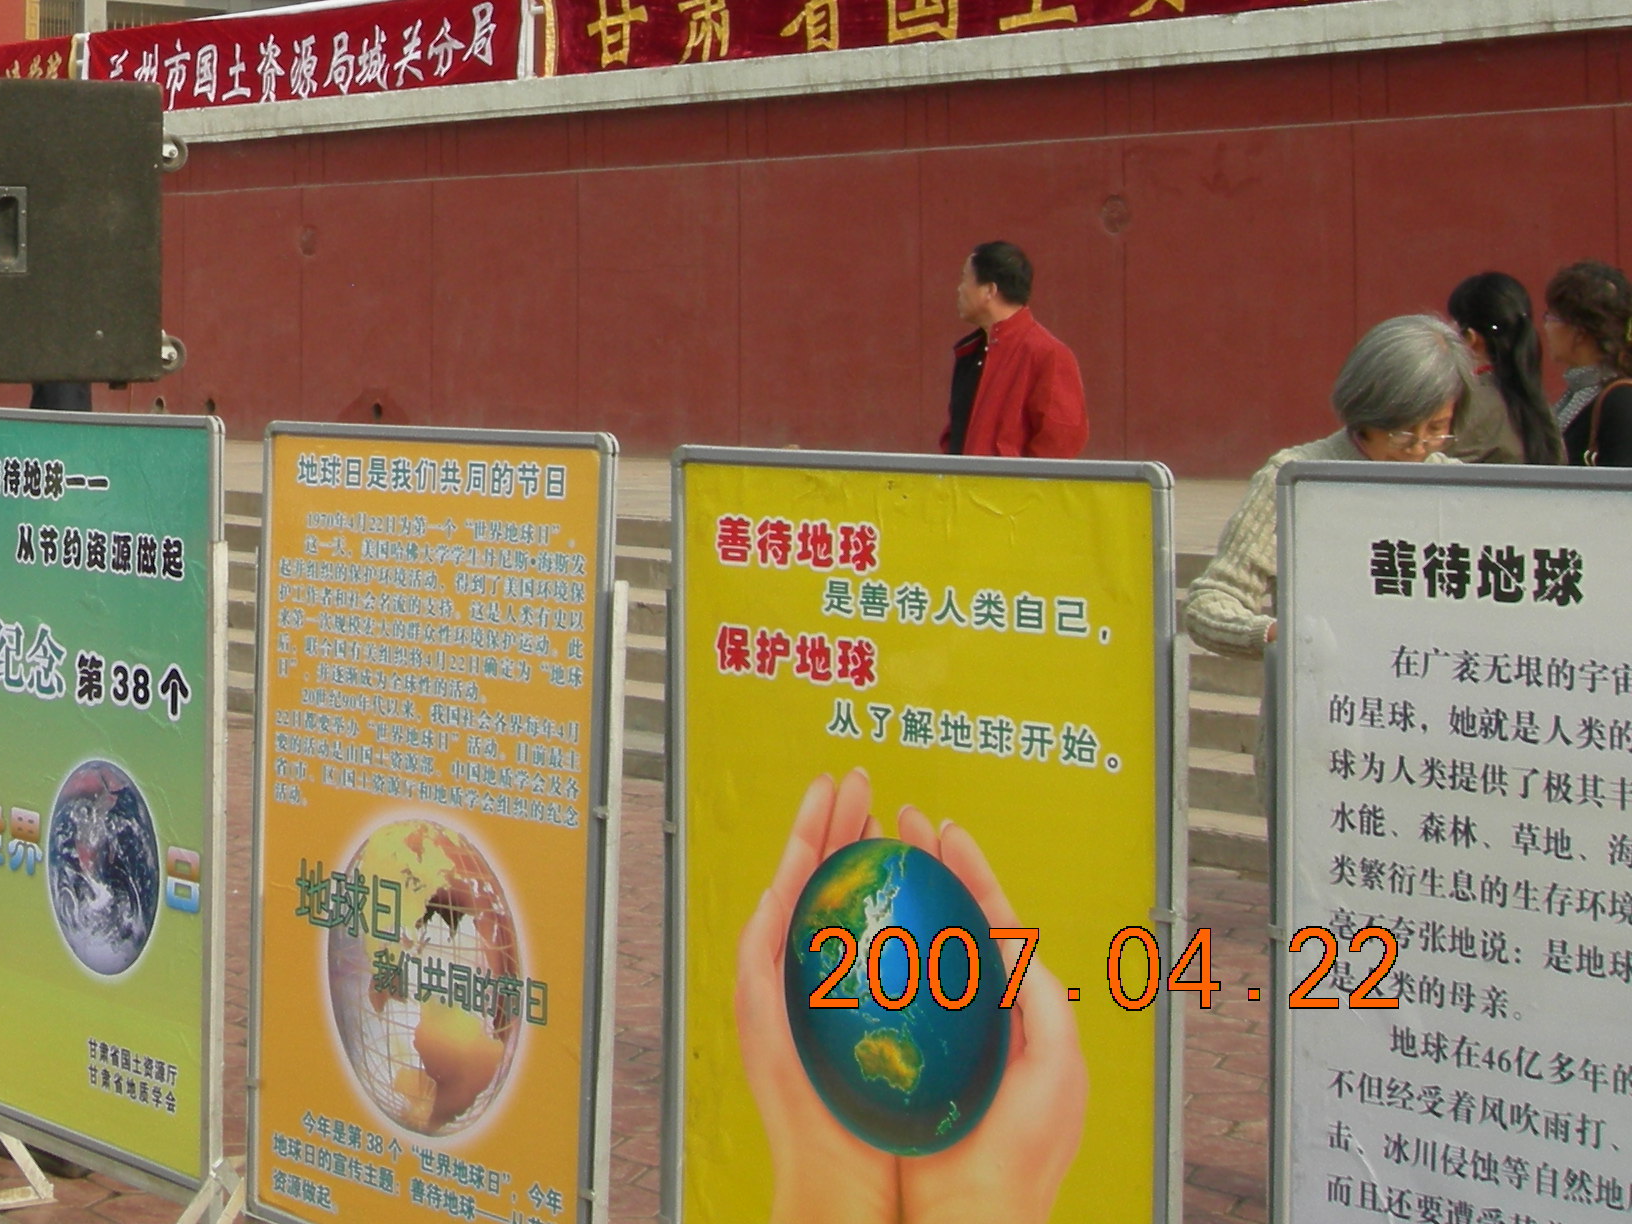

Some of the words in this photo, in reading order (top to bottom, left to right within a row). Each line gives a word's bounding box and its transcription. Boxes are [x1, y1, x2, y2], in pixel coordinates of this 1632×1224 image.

[297, 452, 567, 499] 地球日是我们共同的节日
[16, 523, 185, 581] 从节约资源做起
[716, 514, 880, 572] 善待地球
[1370, 539, 1584, 607] 善待地球
[76, 650, 192, 722] 第38个
[715, 624, 879, 690] 保护地球
[165, 845, 200, 914] 日
[295, 858, 402, 942] 地球日
[372, 948, 548, 1026] 我们共同的节日
[87, 1037, 177, 1086] 甘肃省国土资源厅
[87, 1063, 176, 1114] 甘肃省地质学会
